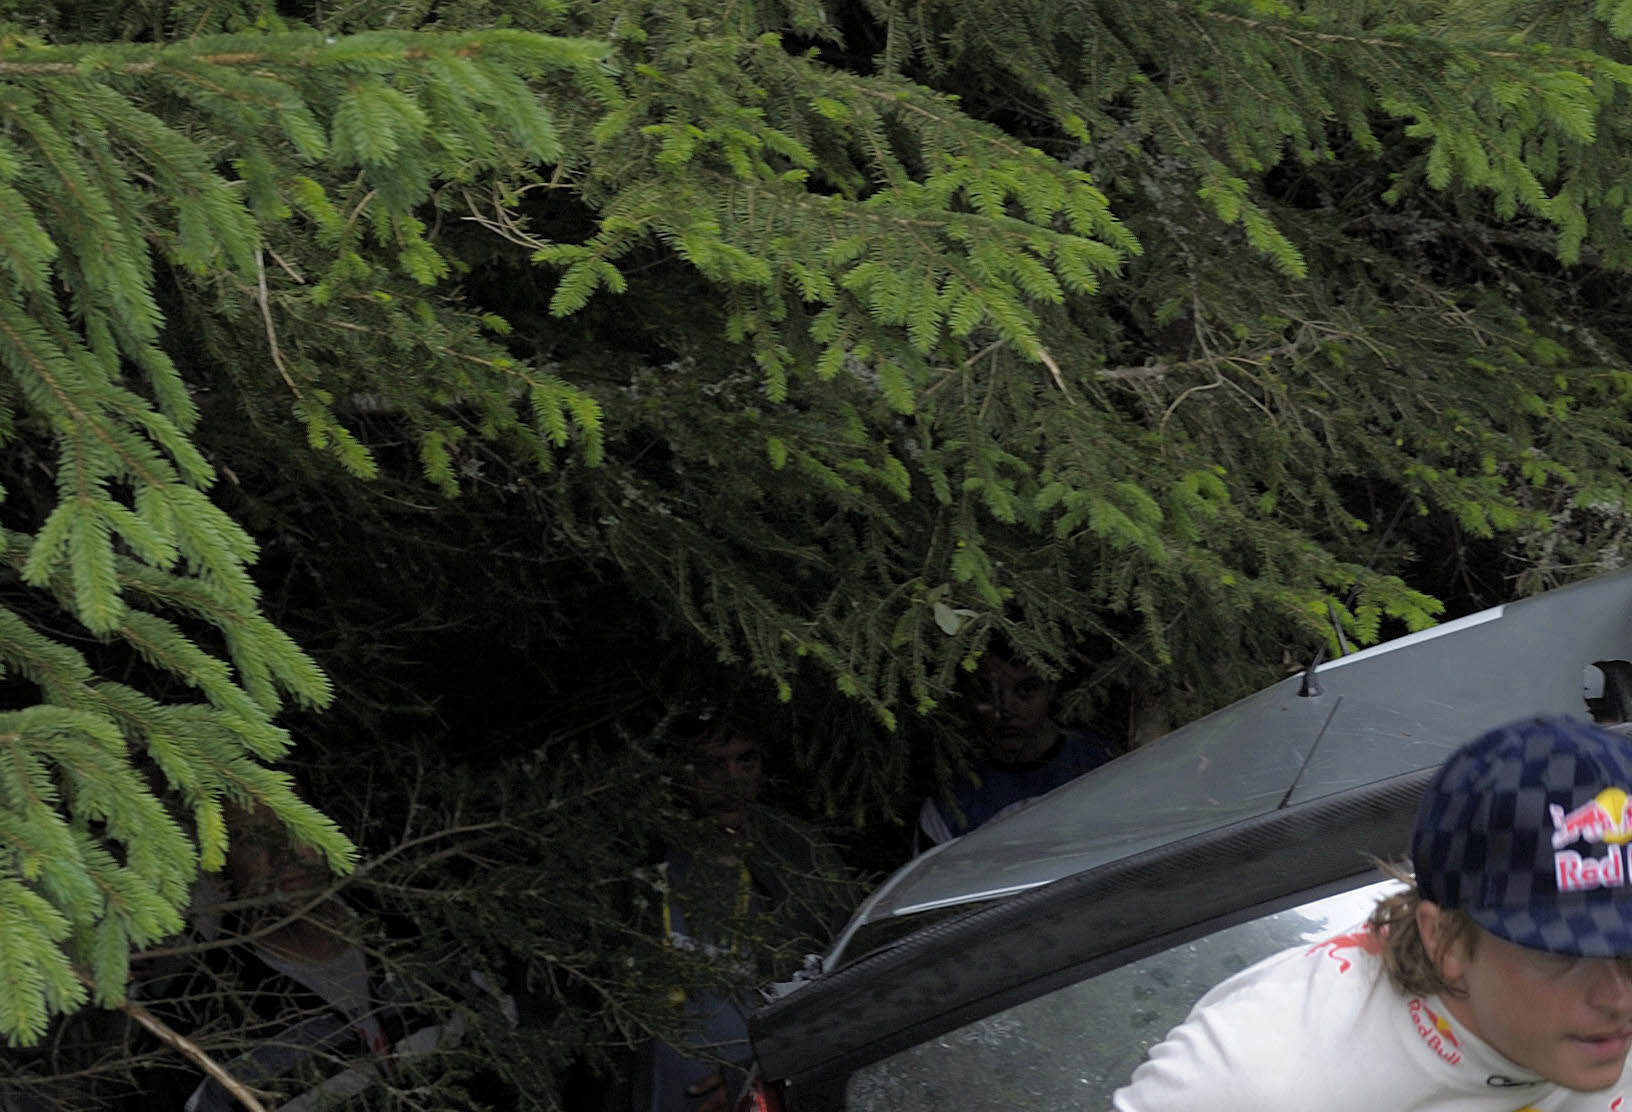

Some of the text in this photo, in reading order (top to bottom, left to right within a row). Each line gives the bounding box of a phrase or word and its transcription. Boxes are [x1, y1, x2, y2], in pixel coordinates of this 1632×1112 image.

[1555, 846, 1624, 891] Red
[1407, 998, 1462, 1065] Red Bull
